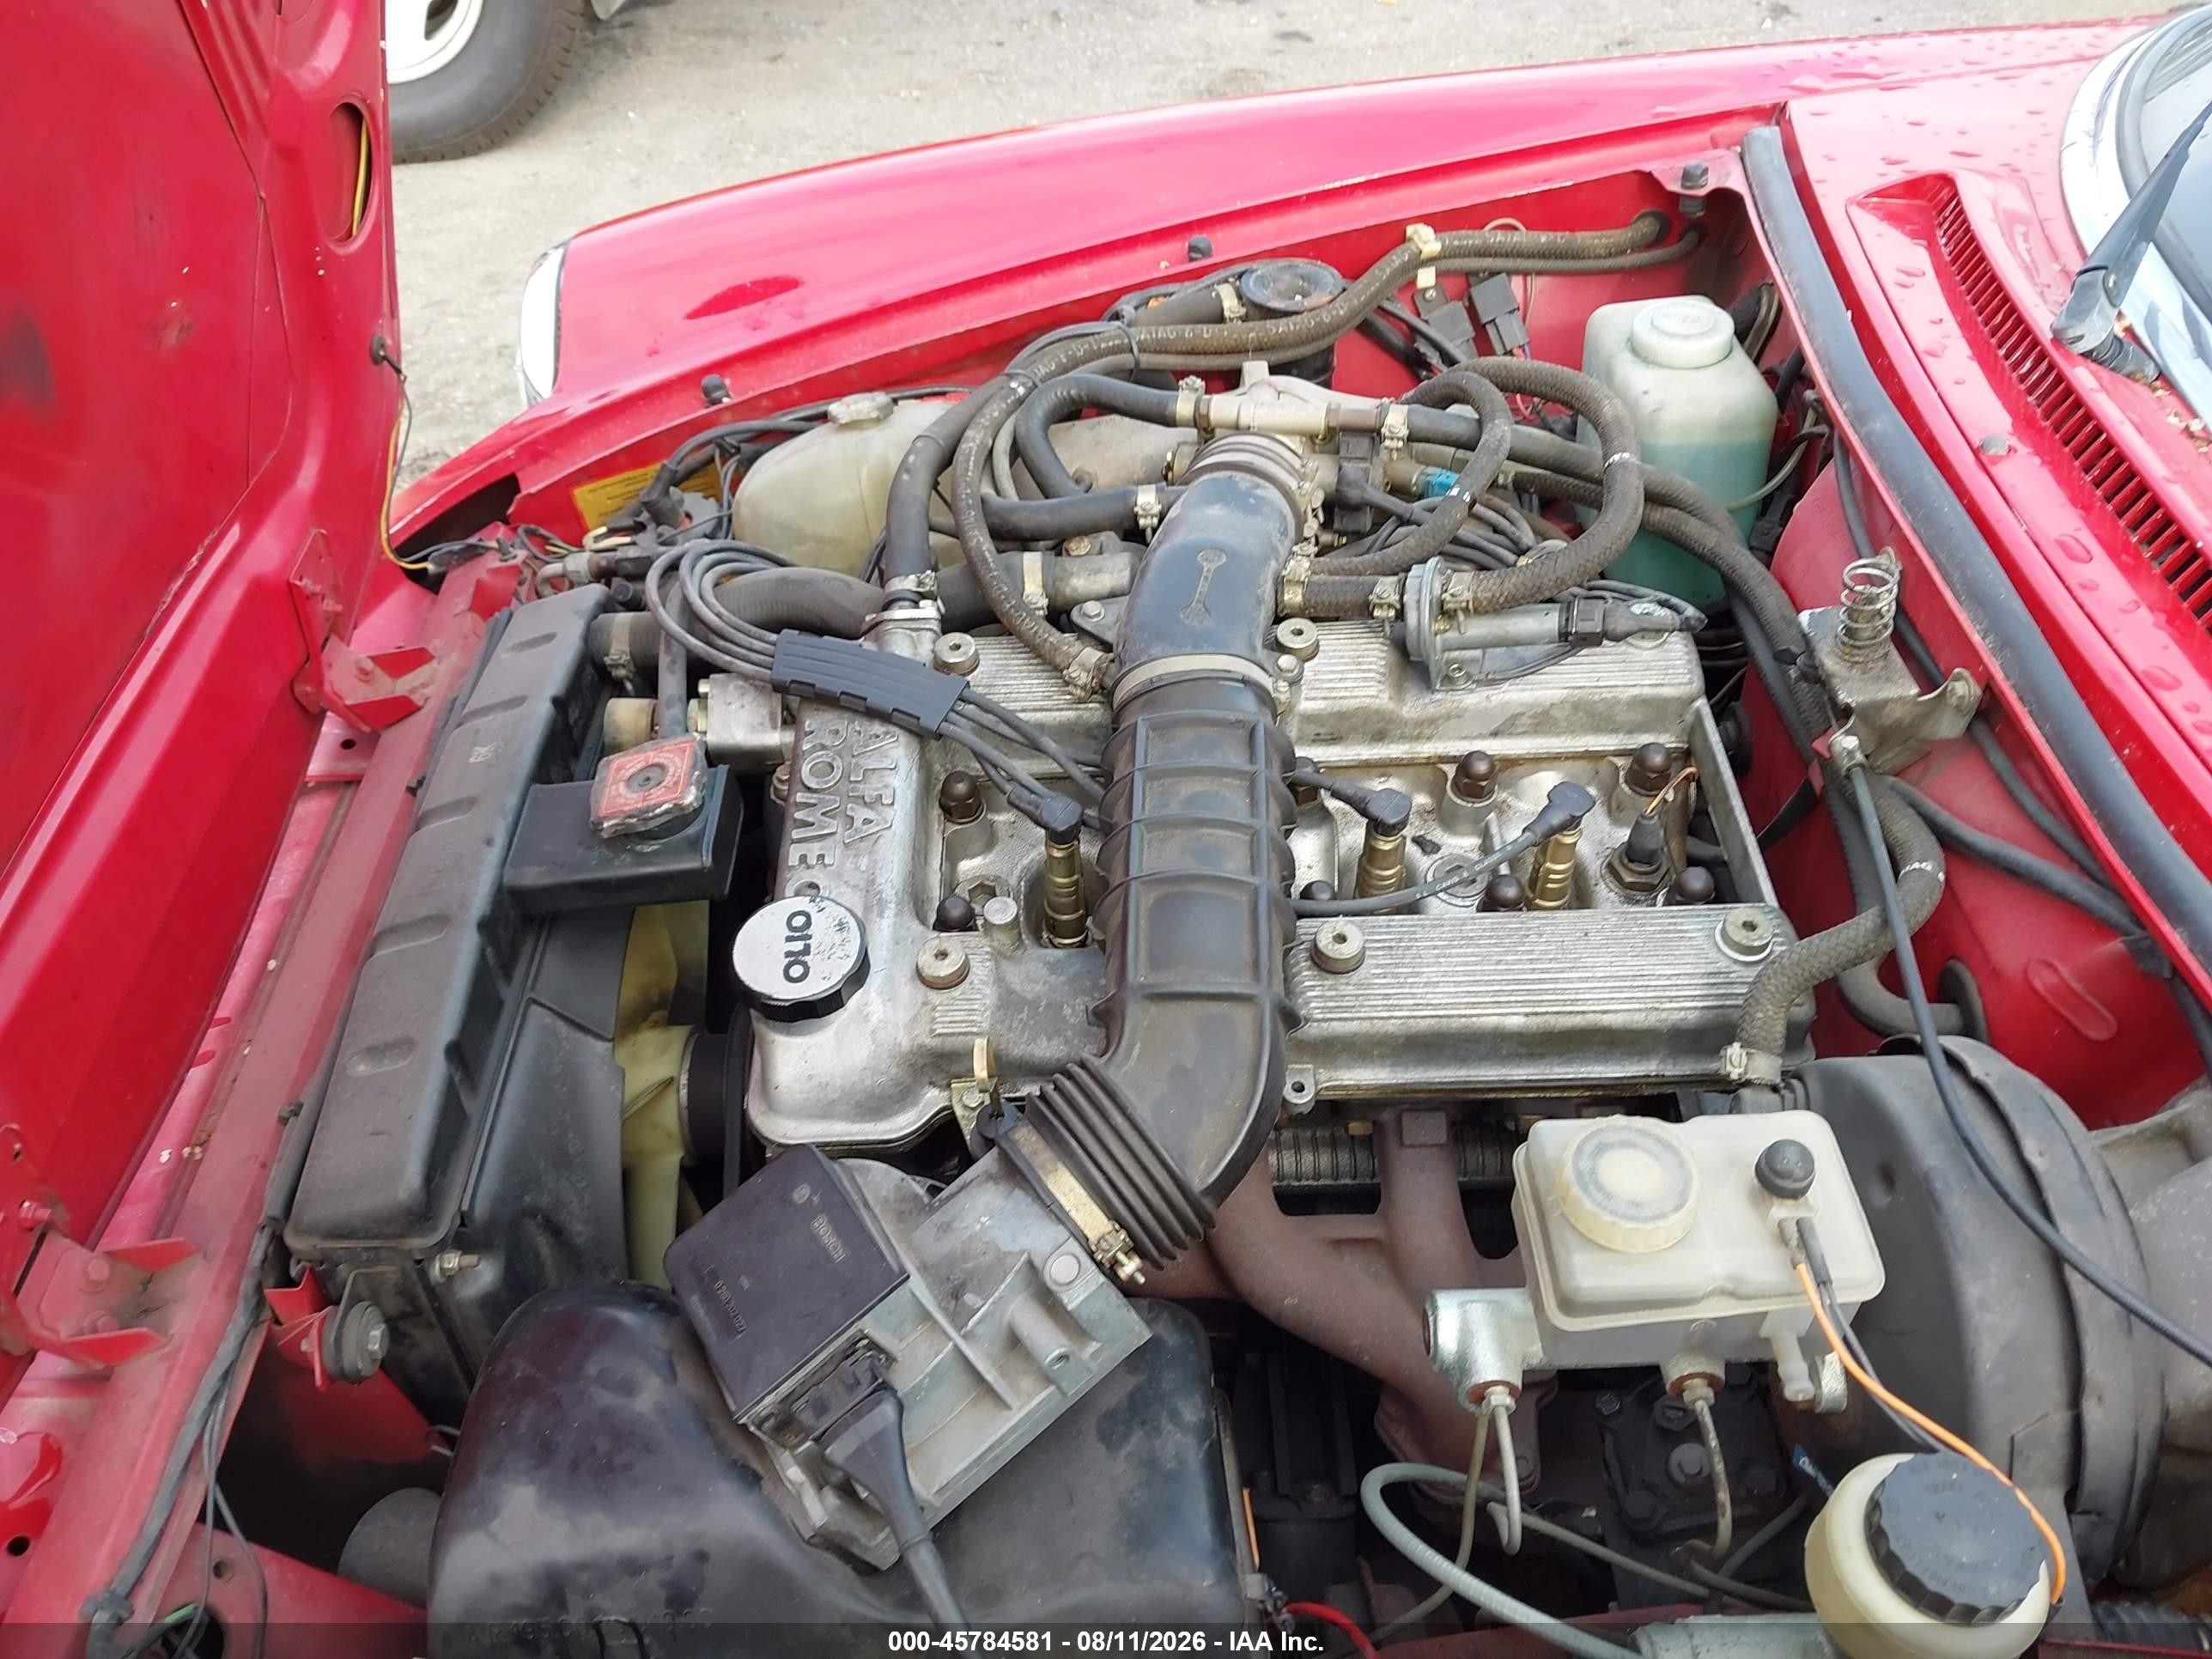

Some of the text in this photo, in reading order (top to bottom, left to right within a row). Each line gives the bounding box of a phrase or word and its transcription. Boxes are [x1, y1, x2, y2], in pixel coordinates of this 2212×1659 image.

[842, 720, 899, 845] ALFA
[782, 910, 813, 984] OLIO
[811, 1214, 847, 1264] BOSCH
